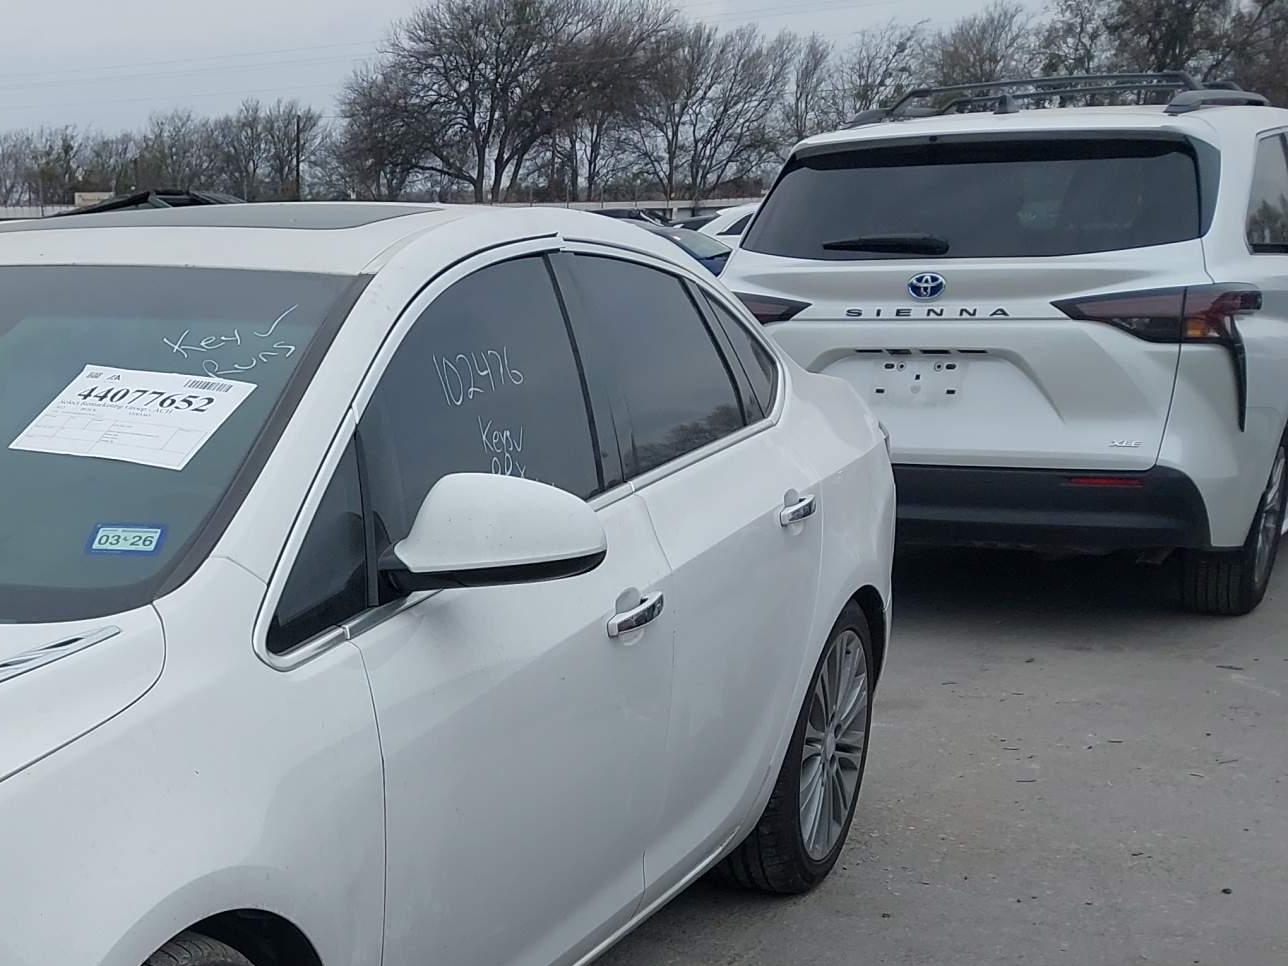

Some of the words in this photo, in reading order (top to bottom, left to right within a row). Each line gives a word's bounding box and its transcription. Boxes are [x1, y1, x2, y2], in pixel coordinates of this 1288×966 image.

[845, 307, 1010, 318] SIENNA
[163, 328, 241, 359] Key
[432, 345, 524, 407] 102476
[77, 385, 215, 413] 44077652
